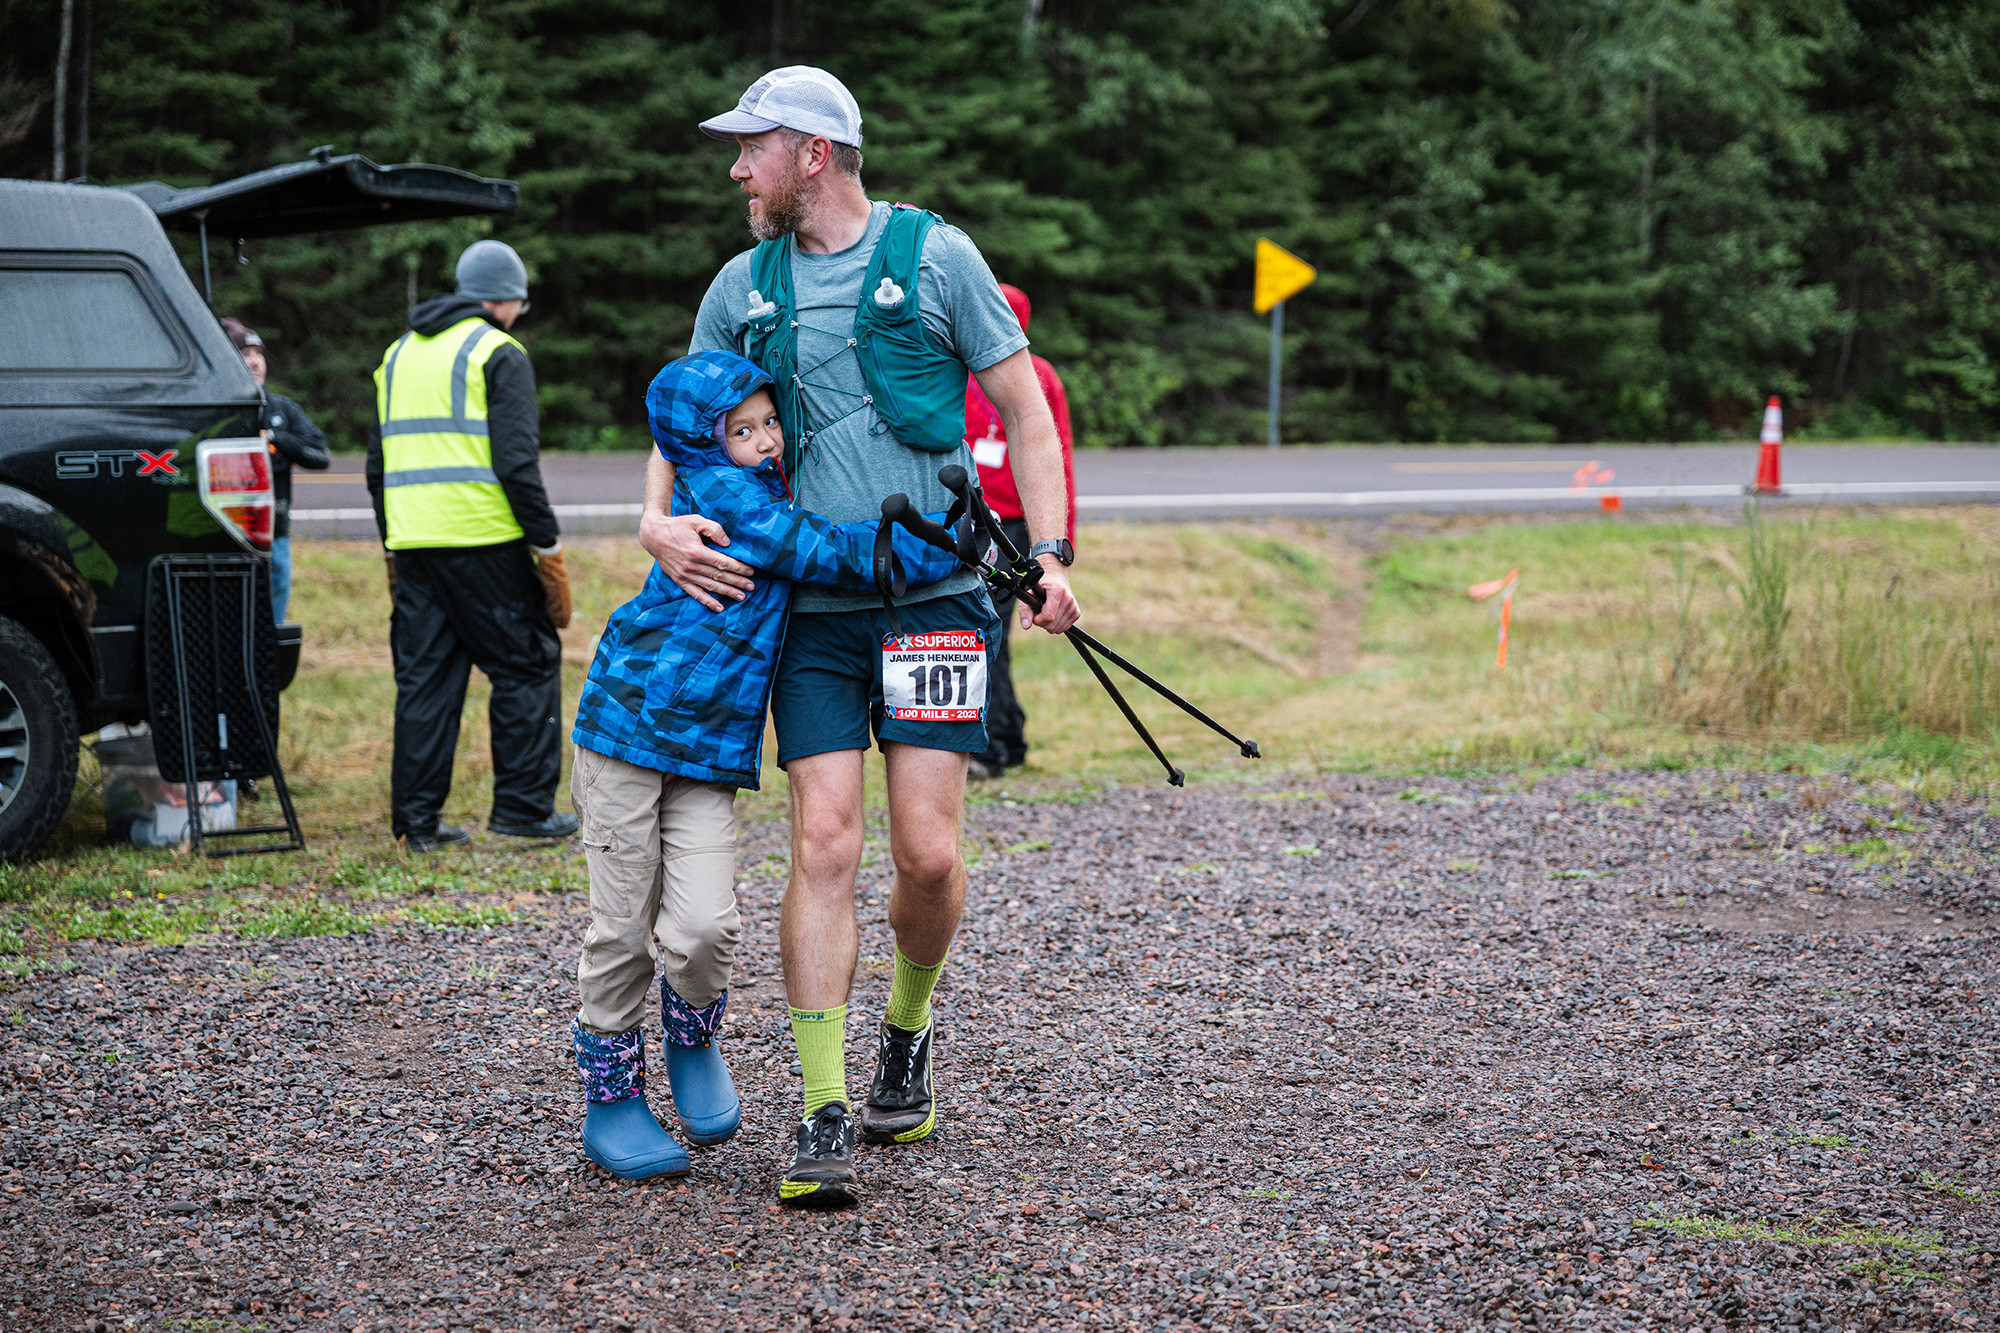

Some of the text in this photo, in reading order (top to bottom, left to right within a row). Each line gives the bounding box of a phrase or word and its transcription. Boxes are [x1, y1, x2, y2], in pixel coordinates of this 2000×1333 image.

[55, 449, 180, 479] STX
[914, 635, 977, 648] SUPERIOR
[889, 653, 980, 663] JAMES HENKELMAN
[908, 664, 968, 706] 107
[899, 709, 918, 718] 100
[921, 710, 949, 719] MILE
[956, 710, 977, 719] 2025
